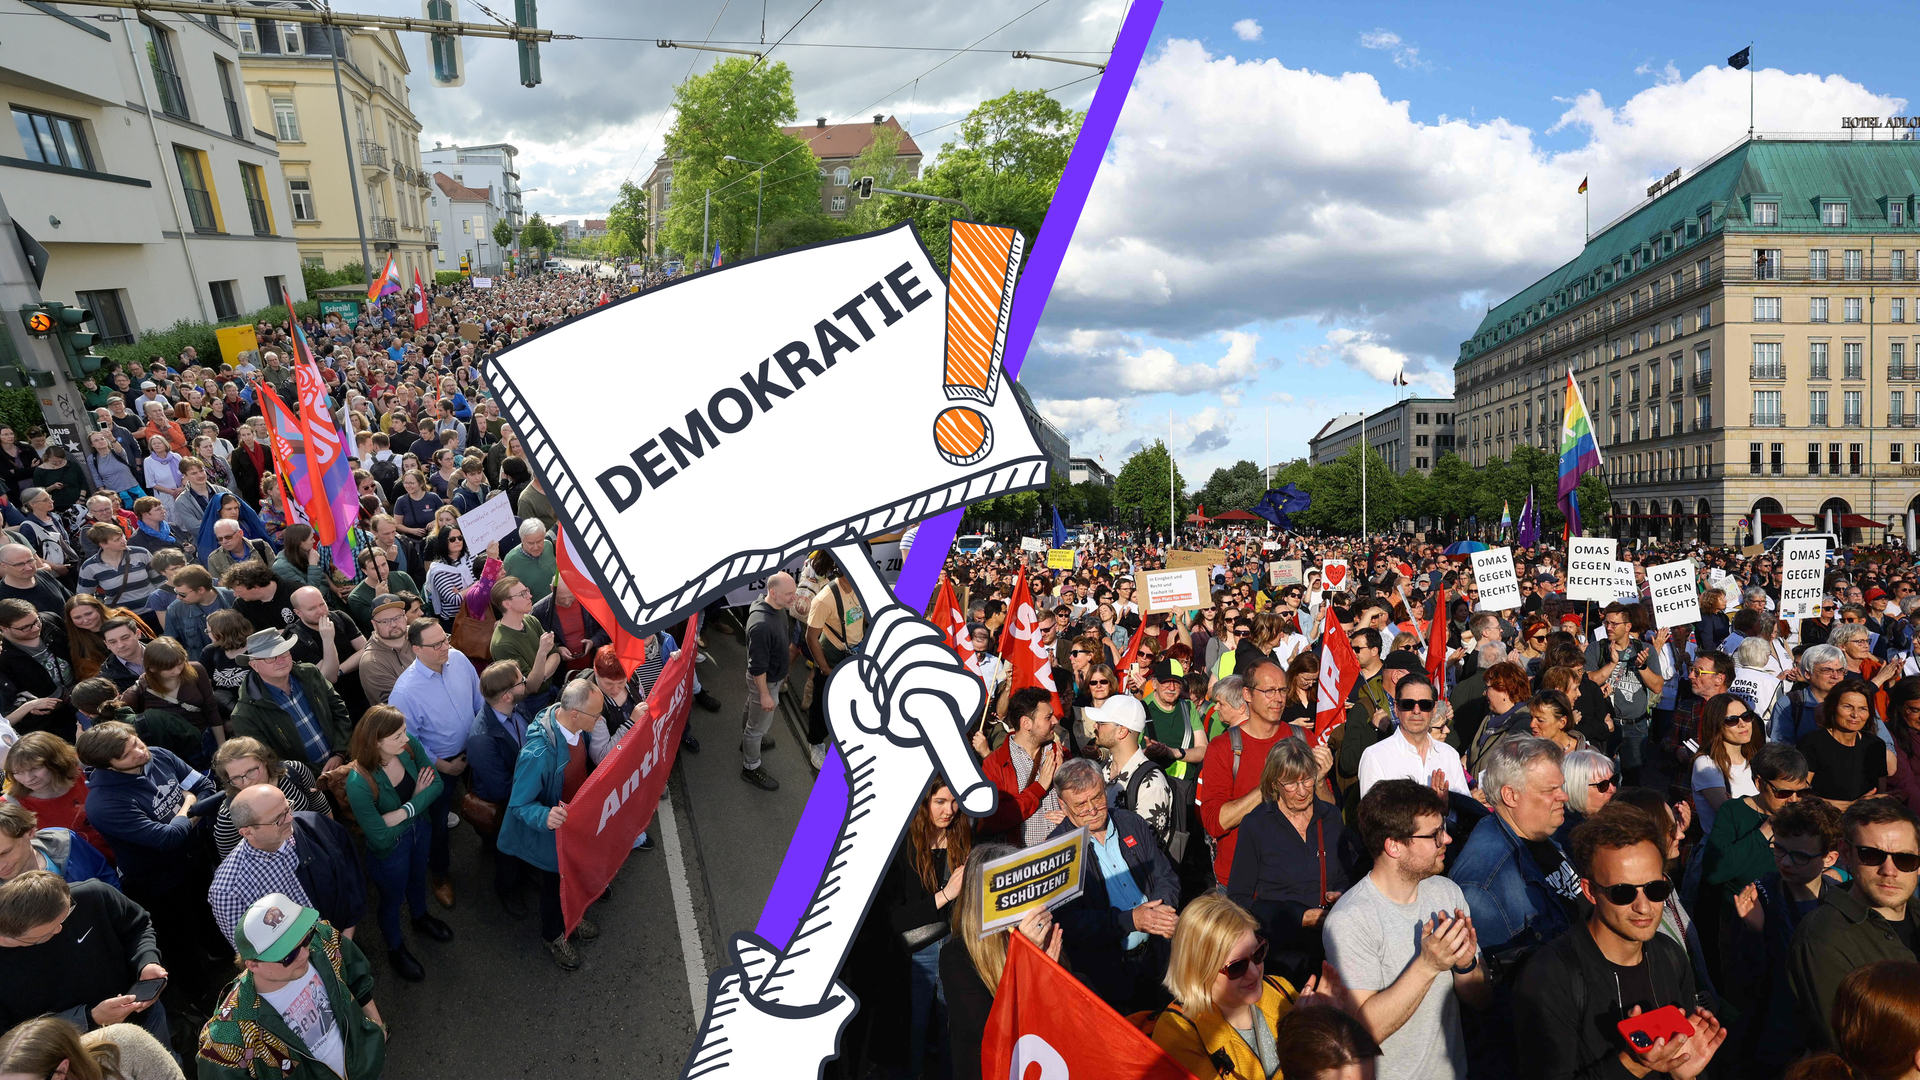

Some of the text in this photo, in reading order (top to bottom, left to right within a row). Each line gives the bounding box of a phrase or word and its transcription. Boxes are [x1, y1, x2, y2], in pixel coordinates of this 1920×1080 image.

[1841, 117, 1920, 128] HOTEL ADLO
[324, 303, 351, 313] Schreib!
[1574, 545, 1610, 555] OMAS
[1789, 549, 1821, 561] OMAS
[1477, 554, 1508, 568] OMAS
[1571, 560, 1611, 571] GEGEN
[1478, 569, 1512, 583] GEGEN
[1653, 568, 1687, 582] OMAS
[1786, 568, 1821, 580] GEGEN
[1569, 576, 1613, 586] RECHTS
[1480, 583, 1517, 598] RECHTS
[1655, 583, 1692, 598] GEGEN
[1783, 587, 1821, 600] RECHTS
[1656, 598, 1697, 614] RECHTS
[1734, 679, 1758, 689] OMAS
[1729, 686, 1758, 696] GEGEN
[995, 849, 1072, 889] DEMOKRATIE
[1000, 872, 1066, 908] SCHÜTZEN!
[292, 992, 308, 1011] 1942
[293, 999, 311, 1018] 2022
